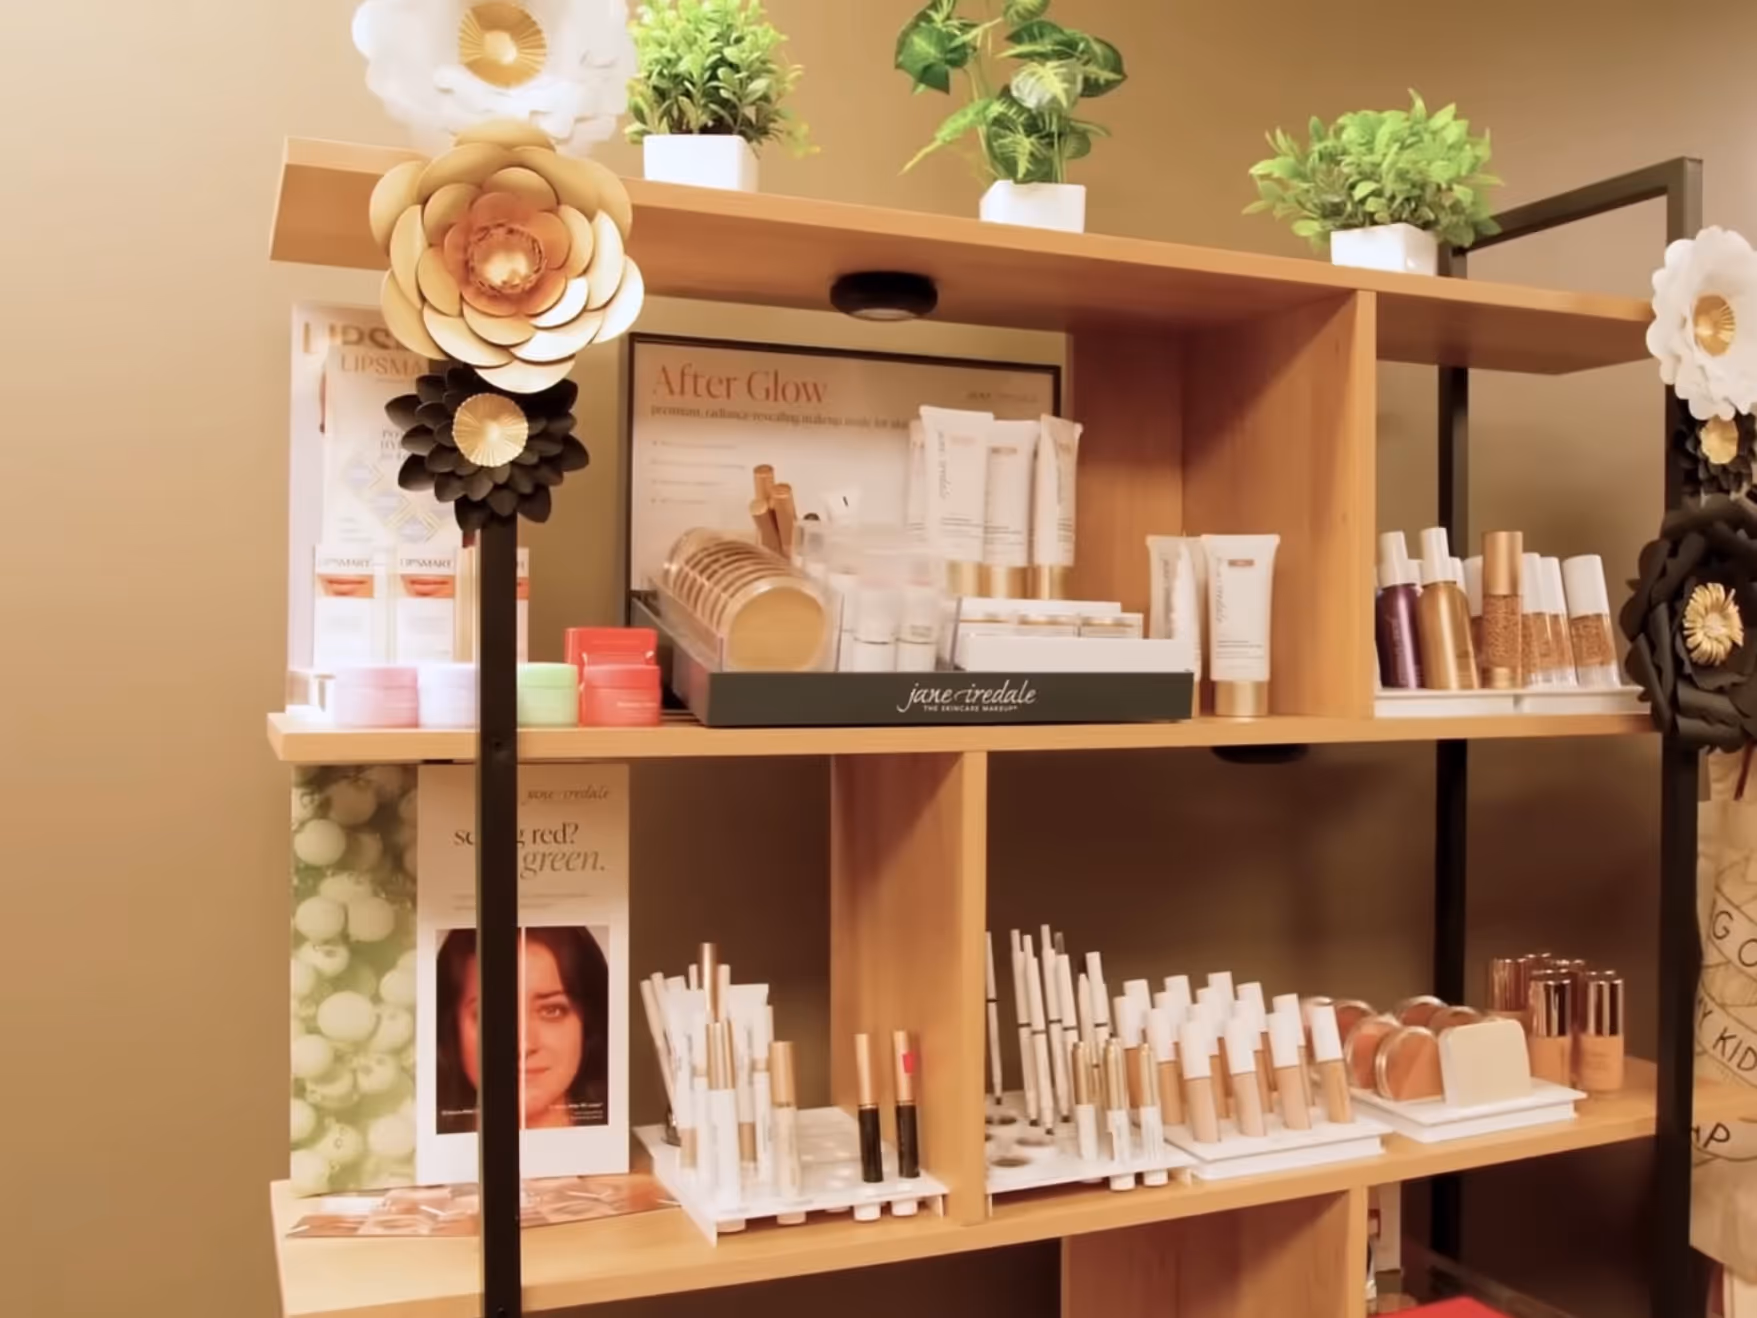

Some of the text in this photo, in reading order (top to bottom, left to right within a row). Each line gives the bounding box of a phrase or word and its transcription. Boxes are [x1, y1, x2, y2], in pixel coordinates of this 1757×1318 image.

[652, 363, 828, 404] After Glow
[399, 558, 453, 568] LIPSMART
[897, 679, 1037, 713] jane iredale
[532, 822, 579, 845] red?
[520, 850, 606, 880] green.
